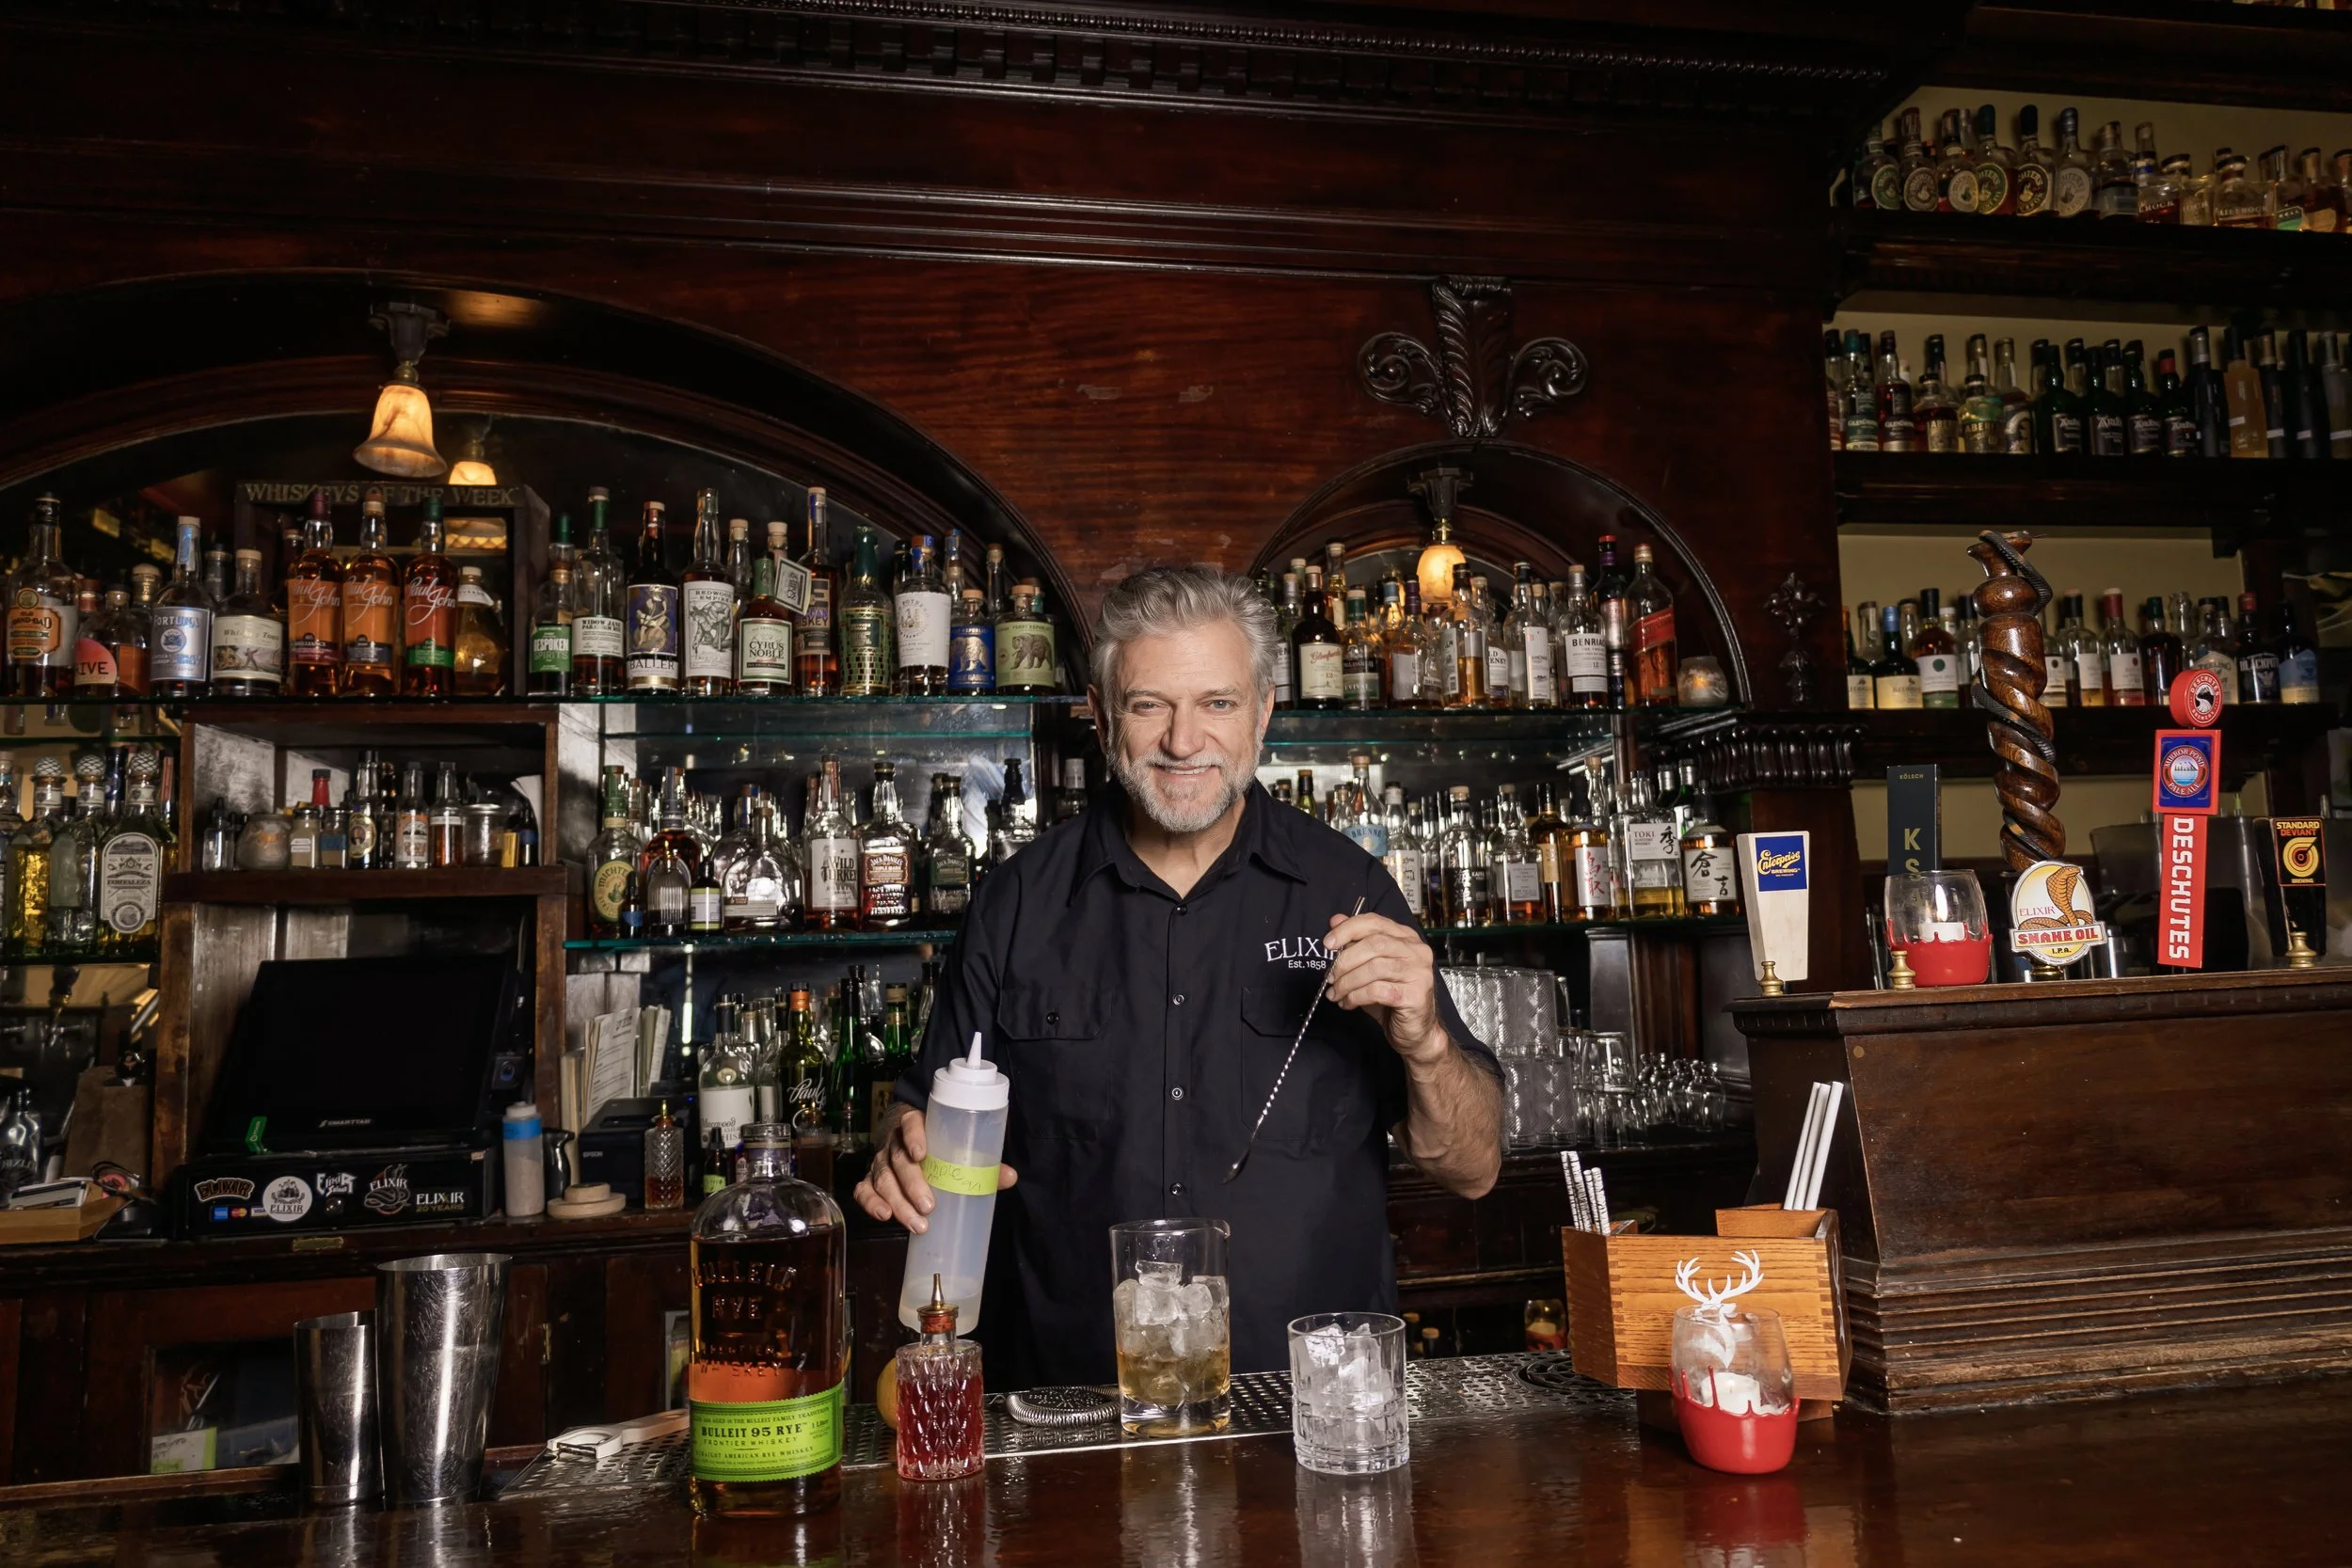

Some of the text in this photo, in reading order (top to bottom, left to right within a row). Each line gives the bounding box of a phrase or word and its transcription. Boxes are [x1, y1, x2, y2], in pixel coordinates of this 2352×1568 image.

[452, 487, 516, 506] WEEK
[749, 641, 785, 650] CYRUS
[749, 649, 785, 659] NOBLE
[629, 657, 675, 670] BALLER
[2164, 749, 2206, 768] MIRROR POND
[2168, 781, 2201, 796] PALE ALE
[2276, 820, 2320, 830] STANDARD
[2280, 828, 2317, 837] DEVIANT
[829, 856, 855, 869] WILD
[1757, 849, 1801, 876] Enterprise
[597, 865, 629, 887] MICHTE
[2169, 816, 2195, 959] DESCHUTES
[2019, 905, 2056, 917] ELIXIR
[2017, 927, 2099, 945] SNAKE OIL
[198, 1179, 252, 1201] ELIXIR
[369, 1178, 409, 1192] ELIXIR
[269, 1204, 304, 1213] ELIXIR
[772, 1415, 796, 1423] FAMILY
[701, 1426, 747, 1438] BULLEIT
[751, 1426, 771, 1437] 95
[703, 1437, 798, 1447] FRONTIER WHISKEY
[695, 1450, 723, 1459] STRAIGHT
[723, 1451, 759, 1460] AMERICAN
[779, 1445, 814, 1456] WHISKEY
